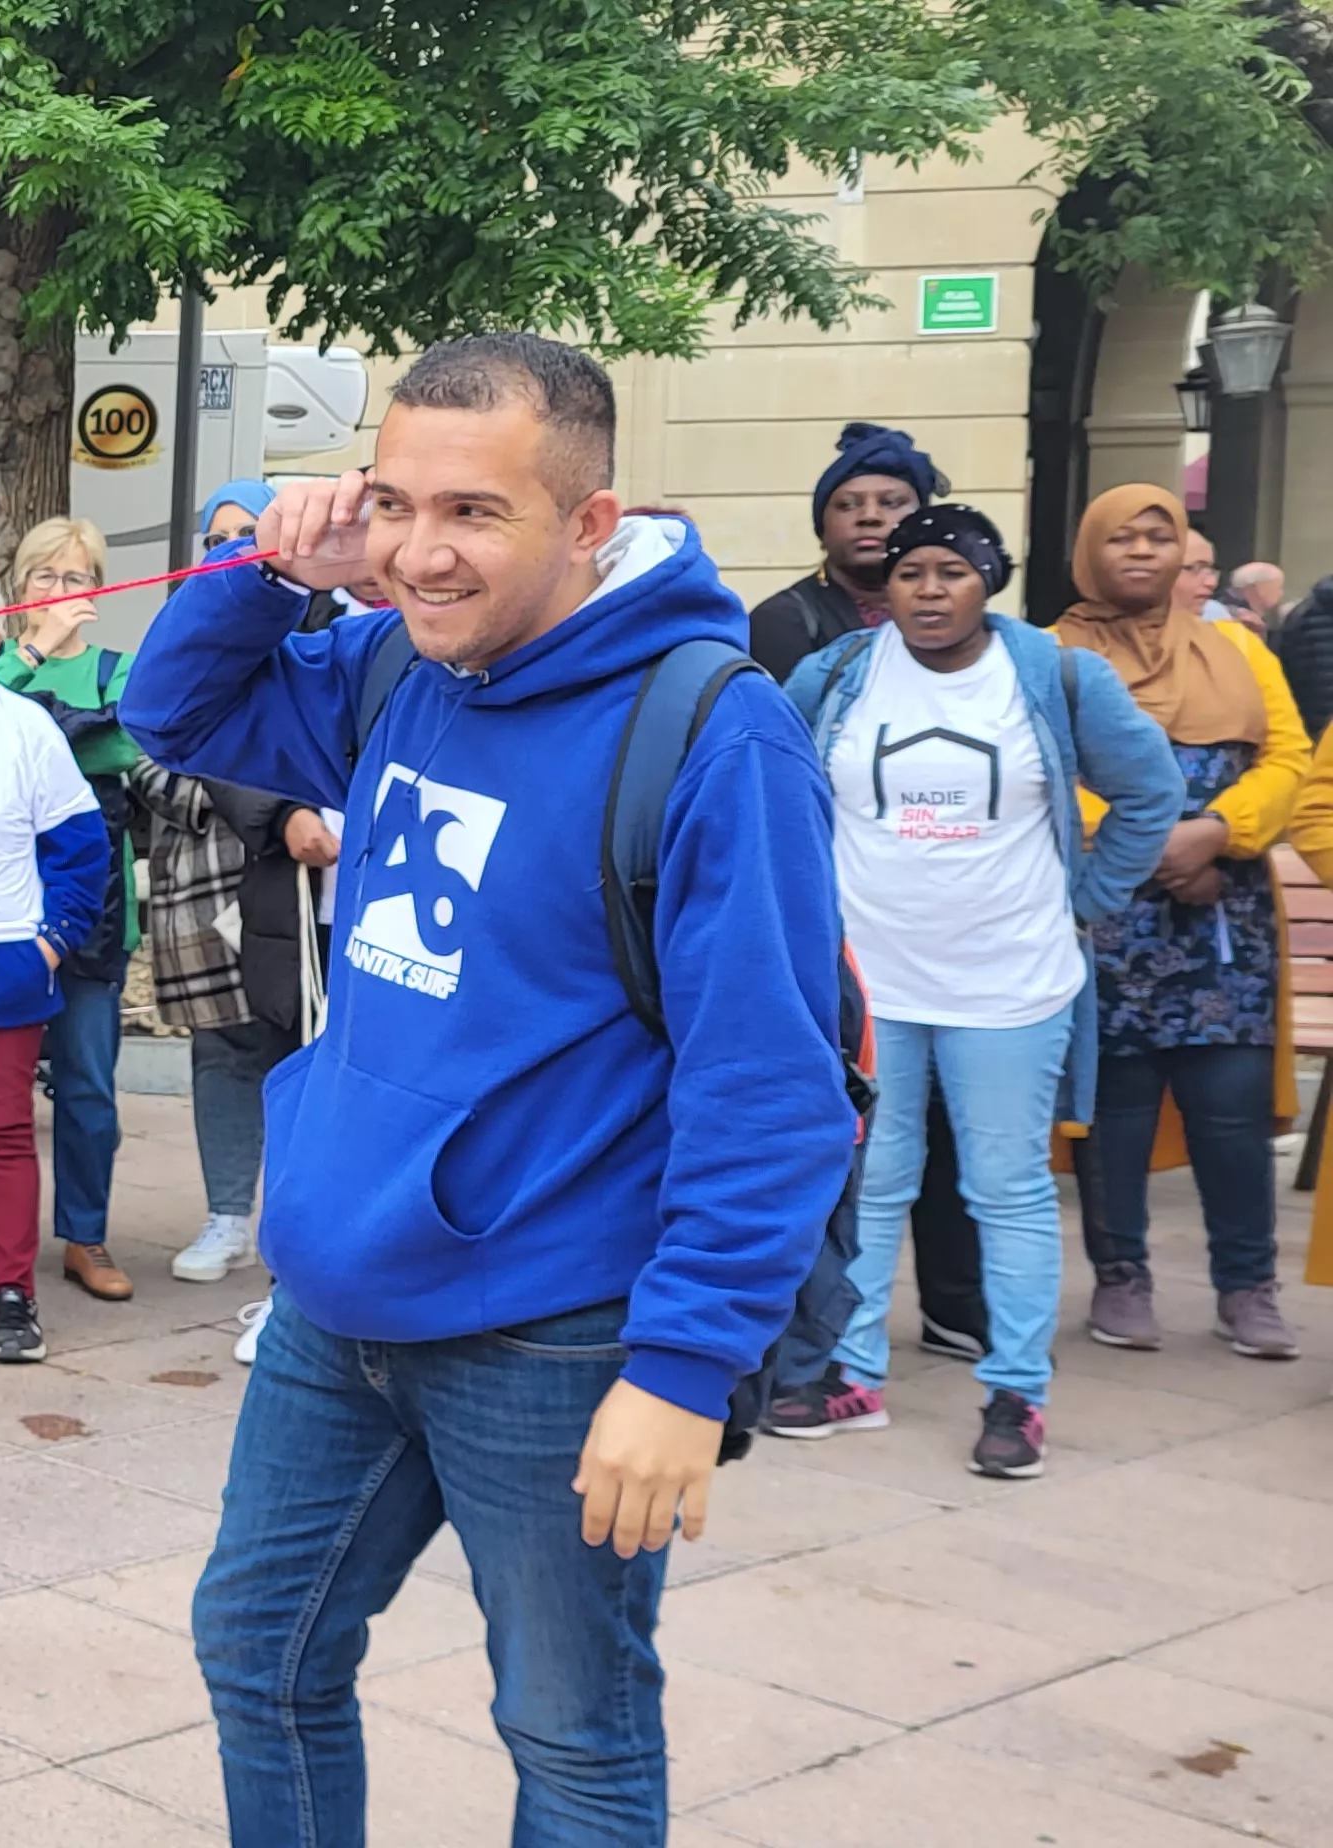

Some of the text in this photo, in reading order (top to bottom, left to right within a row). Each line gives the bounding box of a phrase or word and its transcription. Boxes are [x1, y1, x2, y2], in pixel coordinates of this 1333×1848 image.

[89, 408, 145, 435] 100
[900, 790, 966, 805] NADIE
[901, 808, 936, 822] SIN
[899, 825, 980, 840] HOGAR
